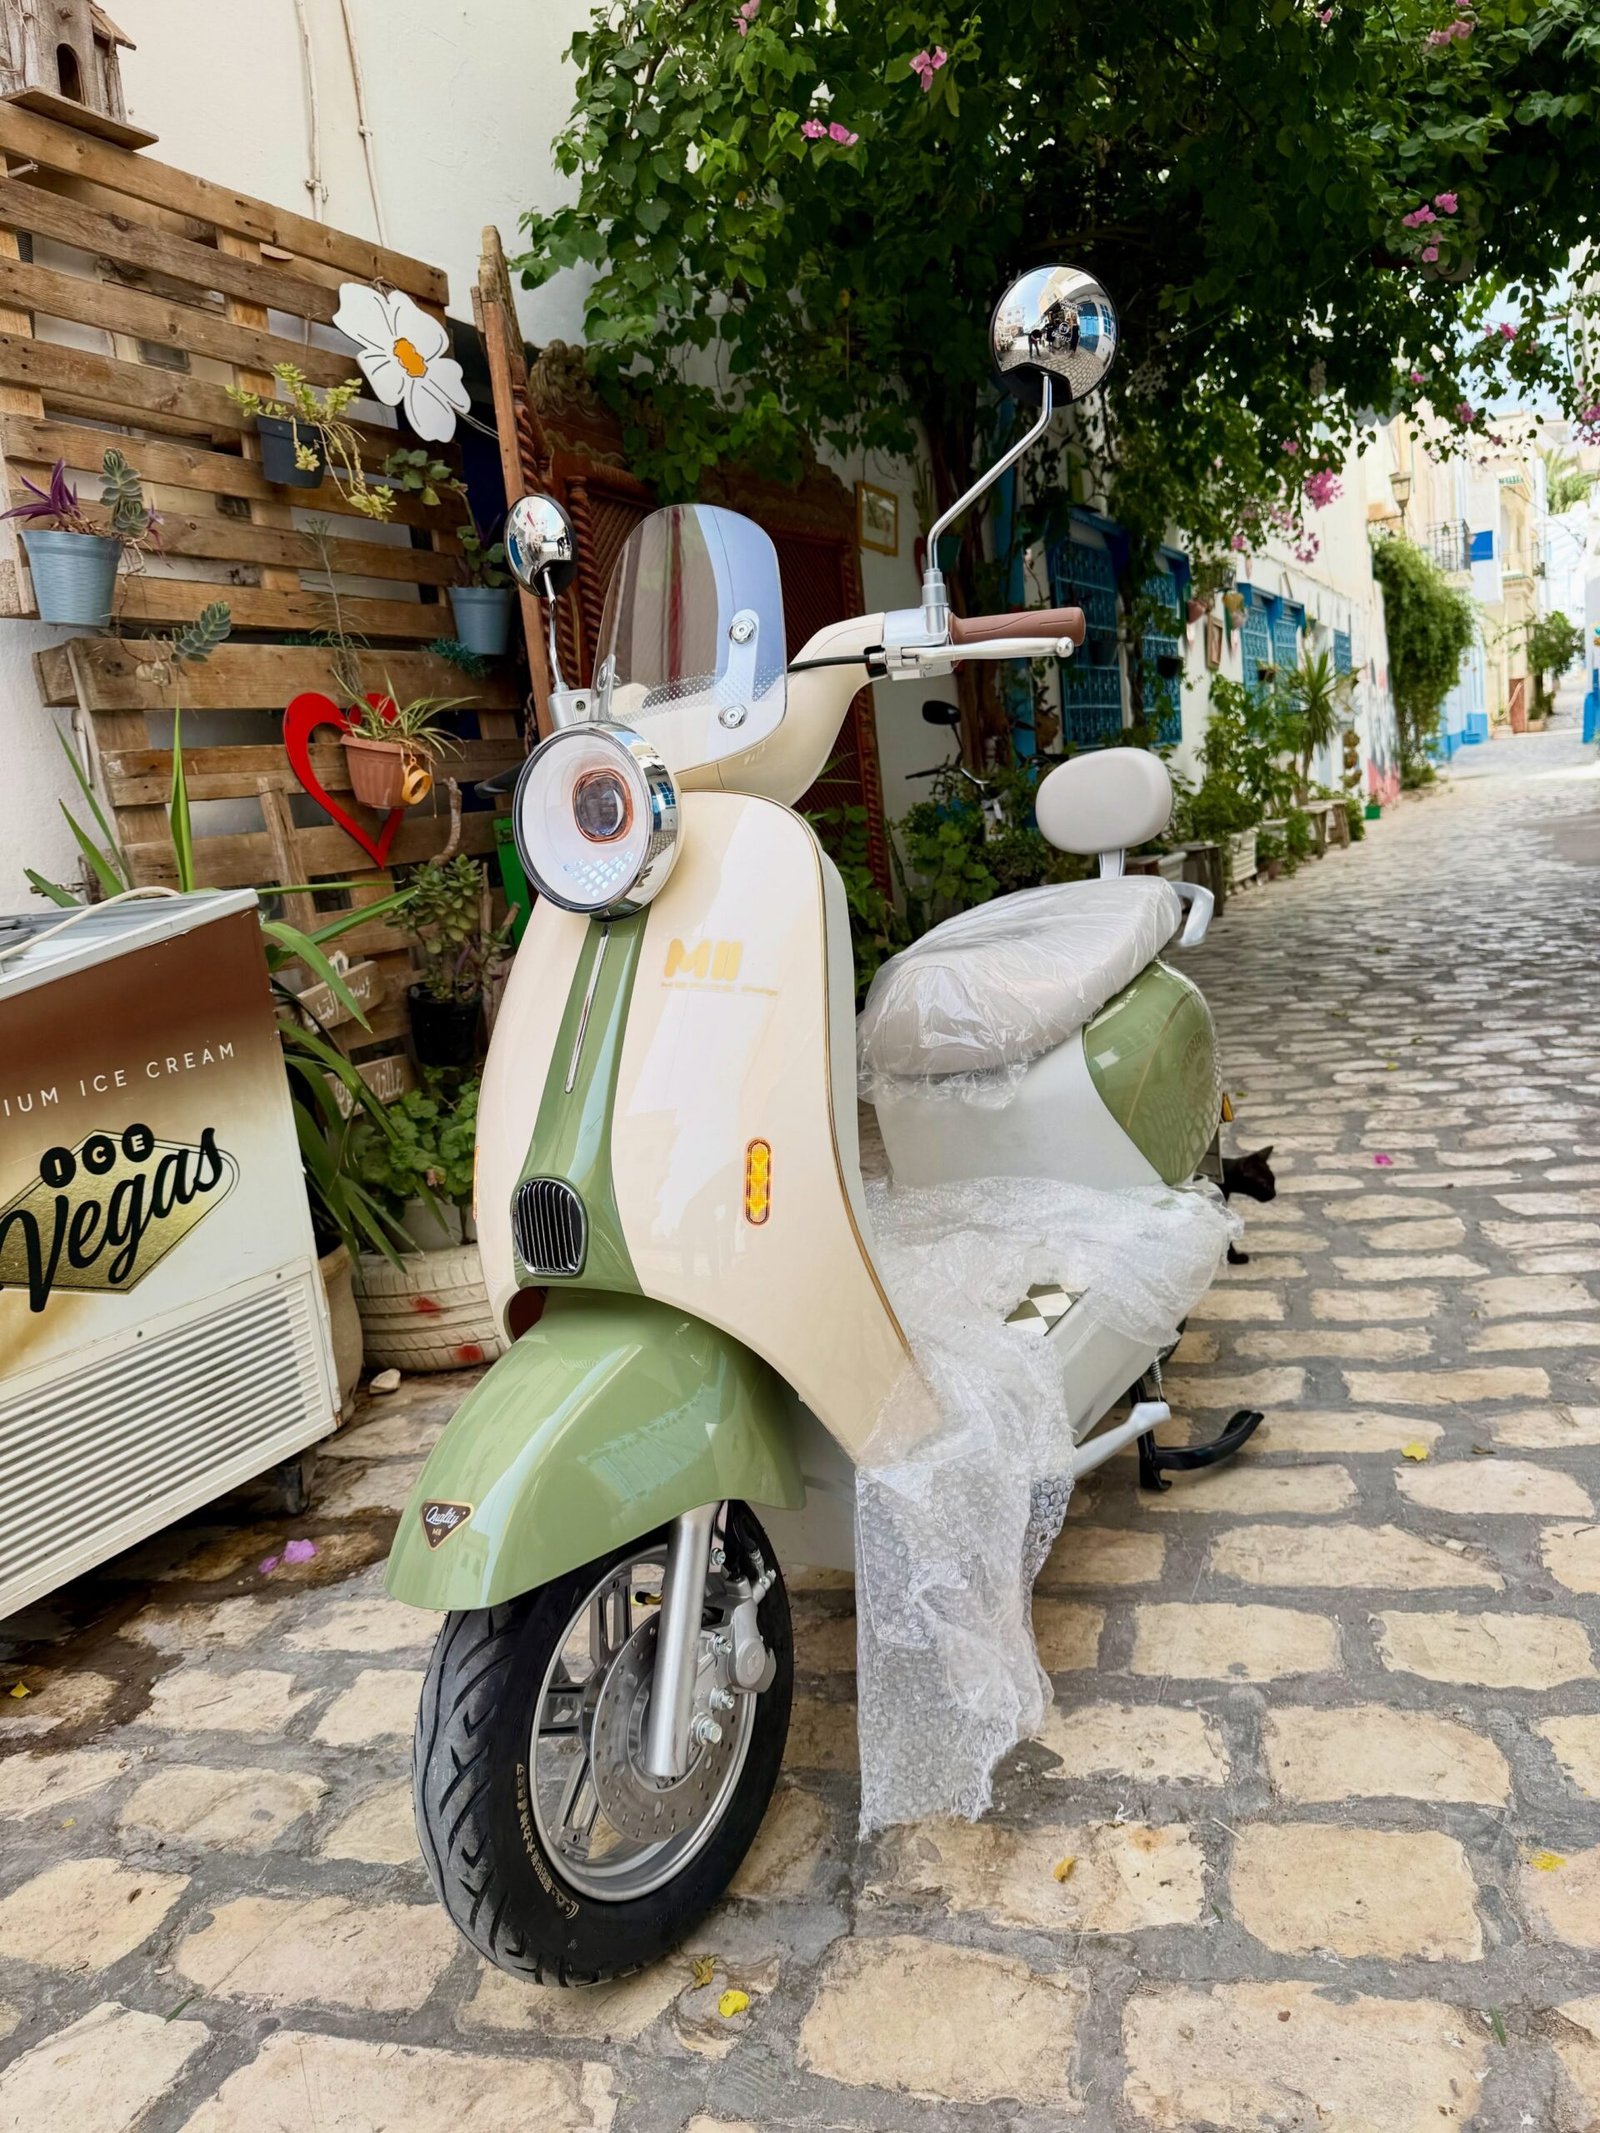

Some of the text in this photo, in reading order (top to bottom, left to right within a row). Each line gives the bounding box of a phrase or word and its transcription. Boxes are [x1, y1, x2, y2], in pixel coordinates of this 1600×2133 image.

[79, 1069, 127, 1097] ICE
[146, 1042, 234, 1079] CREAM
[52, 1132, 147, 1178] ICE
[0, 1127, 223, 1313] Vegas
[425, 1506, 459, 1529] Quality
